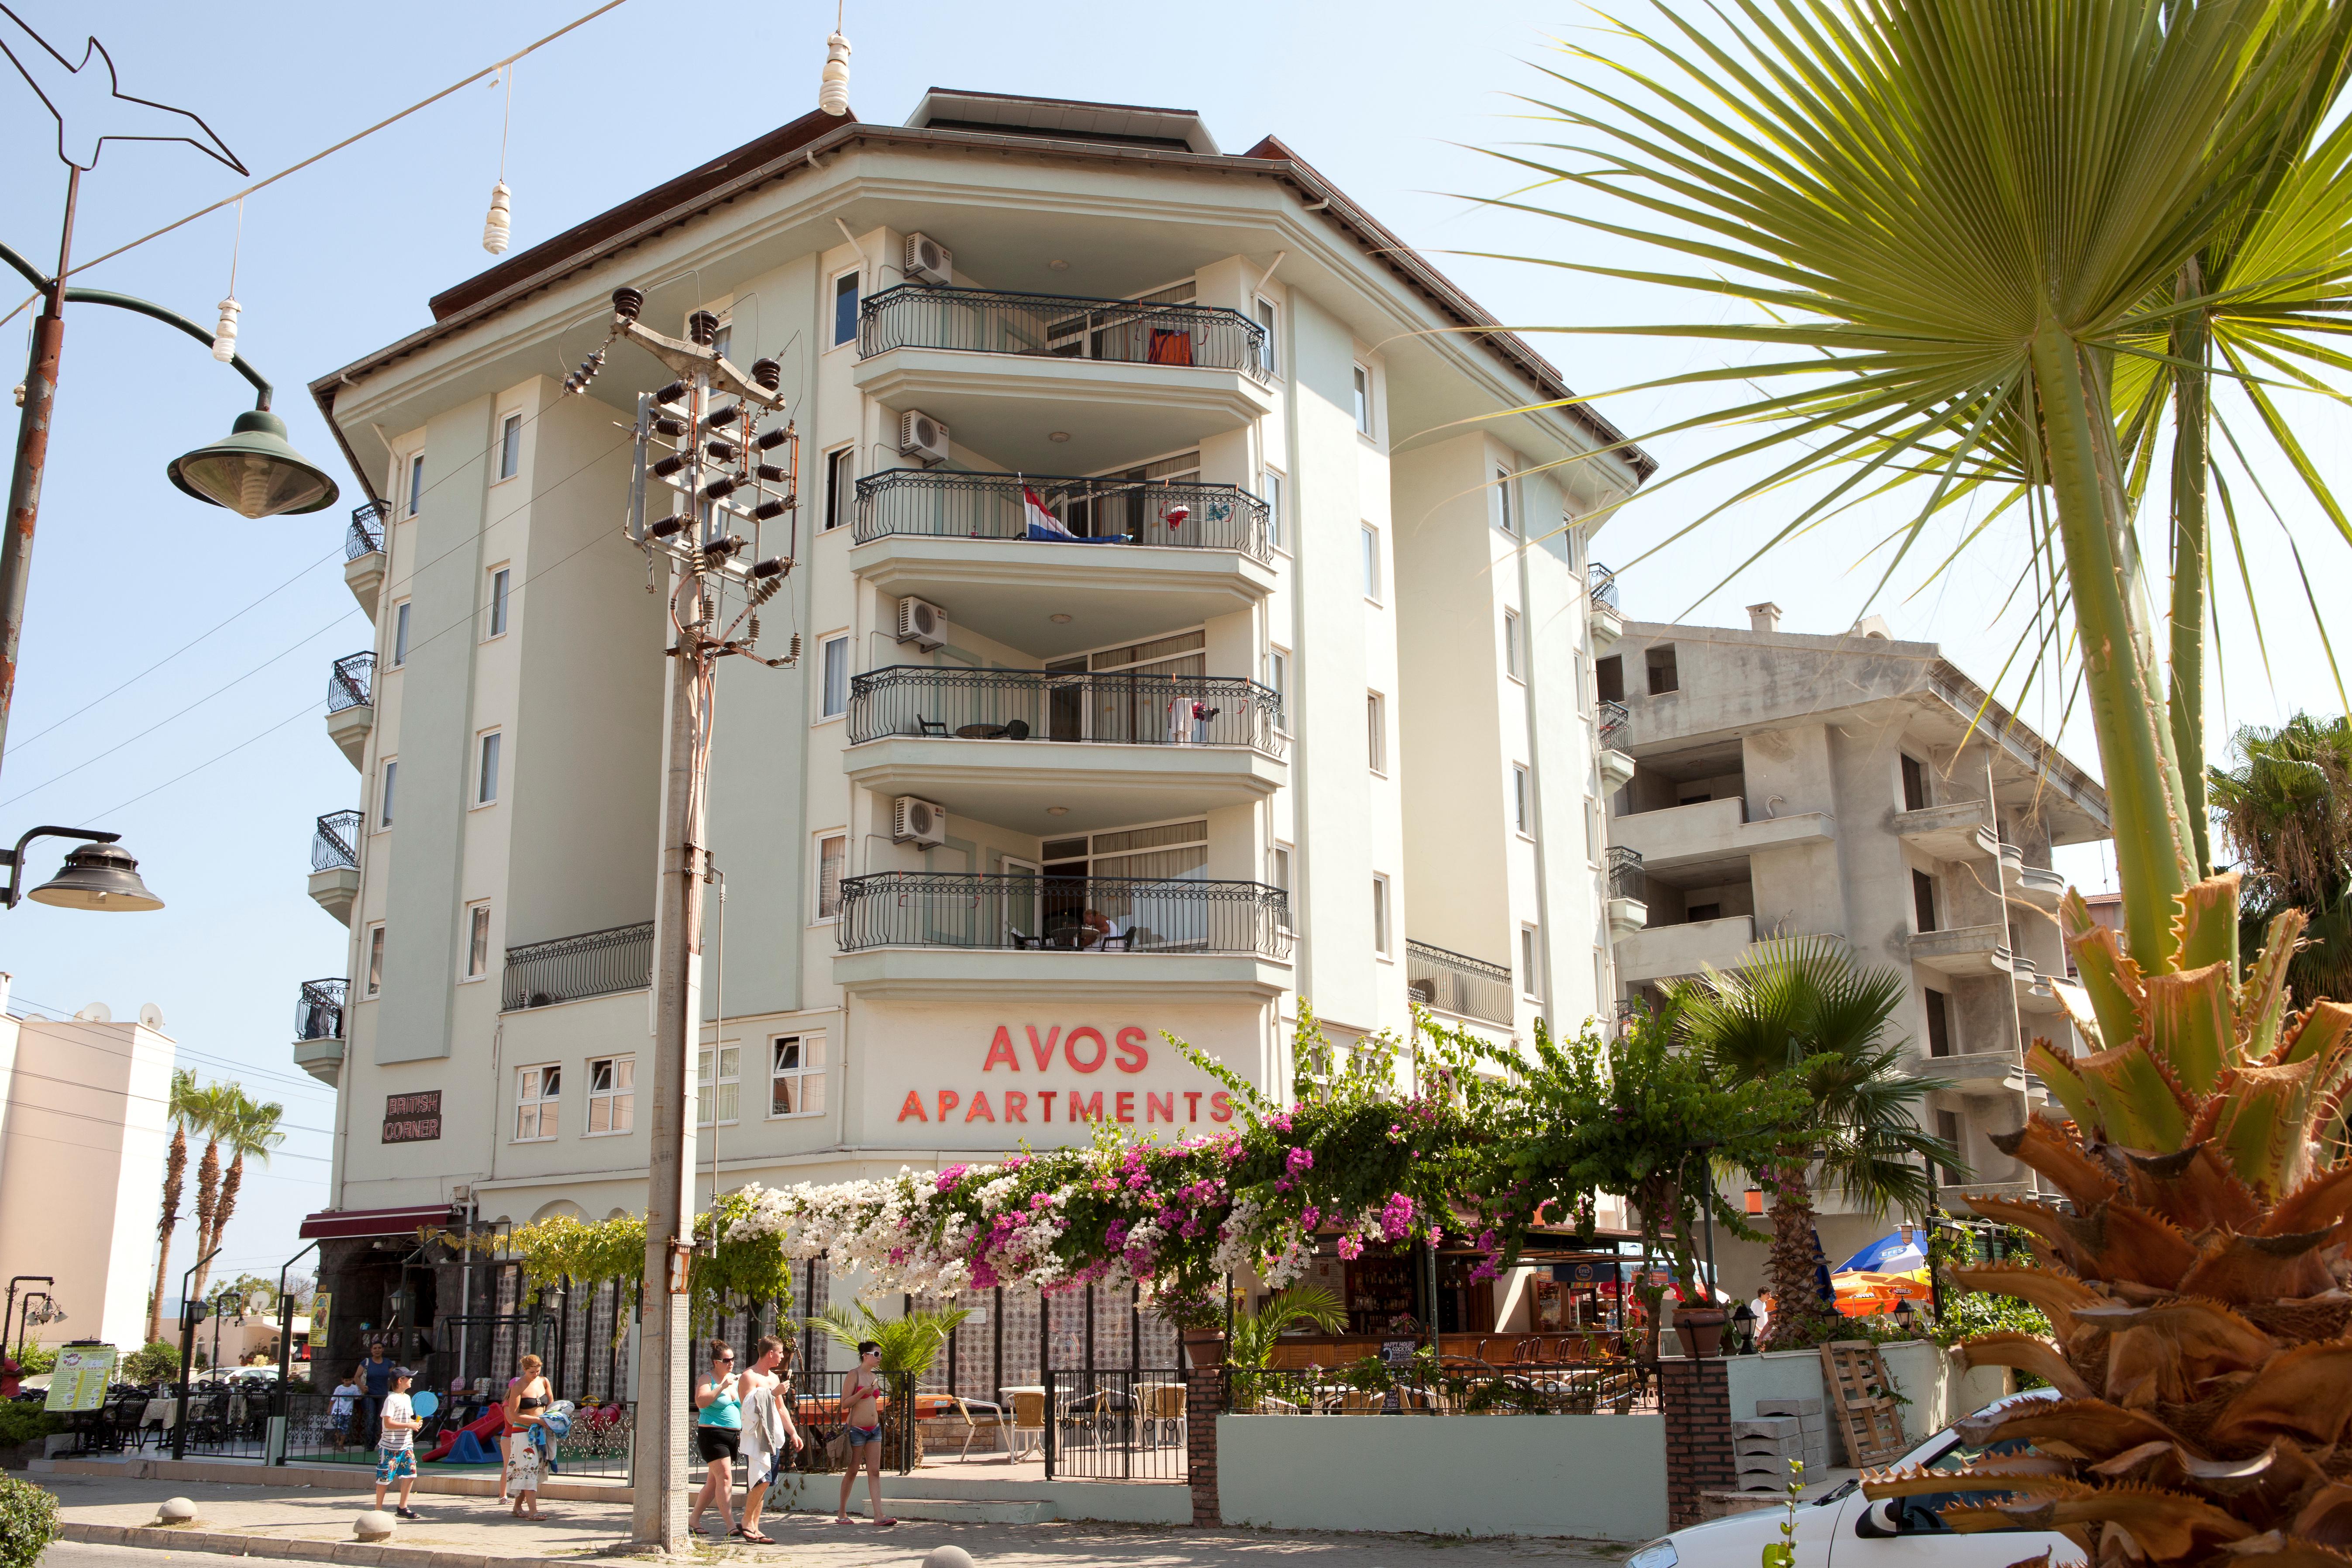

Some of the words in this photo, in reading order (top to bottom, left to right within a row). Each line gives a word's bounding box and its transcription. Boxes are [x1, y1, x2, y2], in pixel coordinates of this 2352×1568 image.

[983, 1025, 1148, 1073] AVOS
[387, 1094, 438, 1115] BRITISH
[897, 1090, 1233, 1122] APARTMENTS
[383, 1119, 438, 1140] CORNER
[1881, 1247, 1904, 1257] EFES
